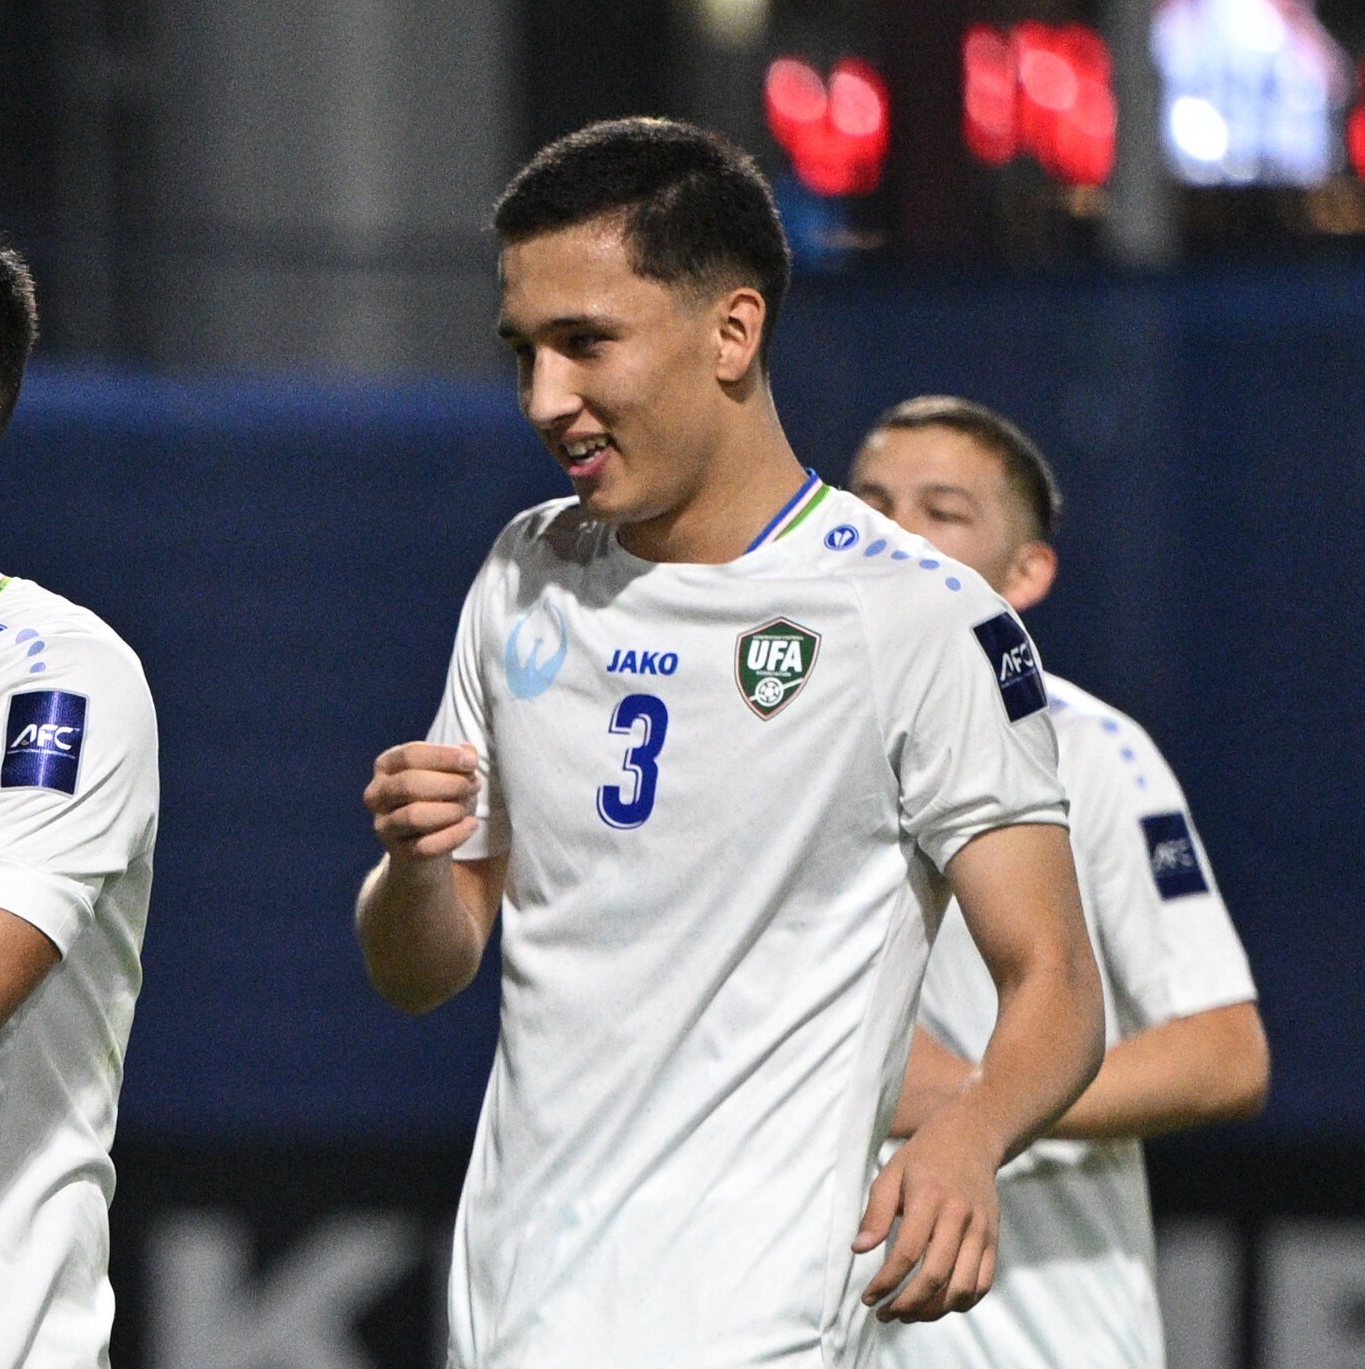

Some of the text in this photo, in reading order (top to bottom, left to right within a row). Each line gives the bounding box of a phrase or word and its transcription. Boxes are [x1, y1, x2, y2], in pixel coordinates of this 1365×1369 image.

[606, 648, 679, 676] JAKO
[747, 640, 802, 672] UFA
[999, 643, 1033, 681] AFC
[10, 723, 78, 751] AFC
[597, 693, 669, 830] 3
